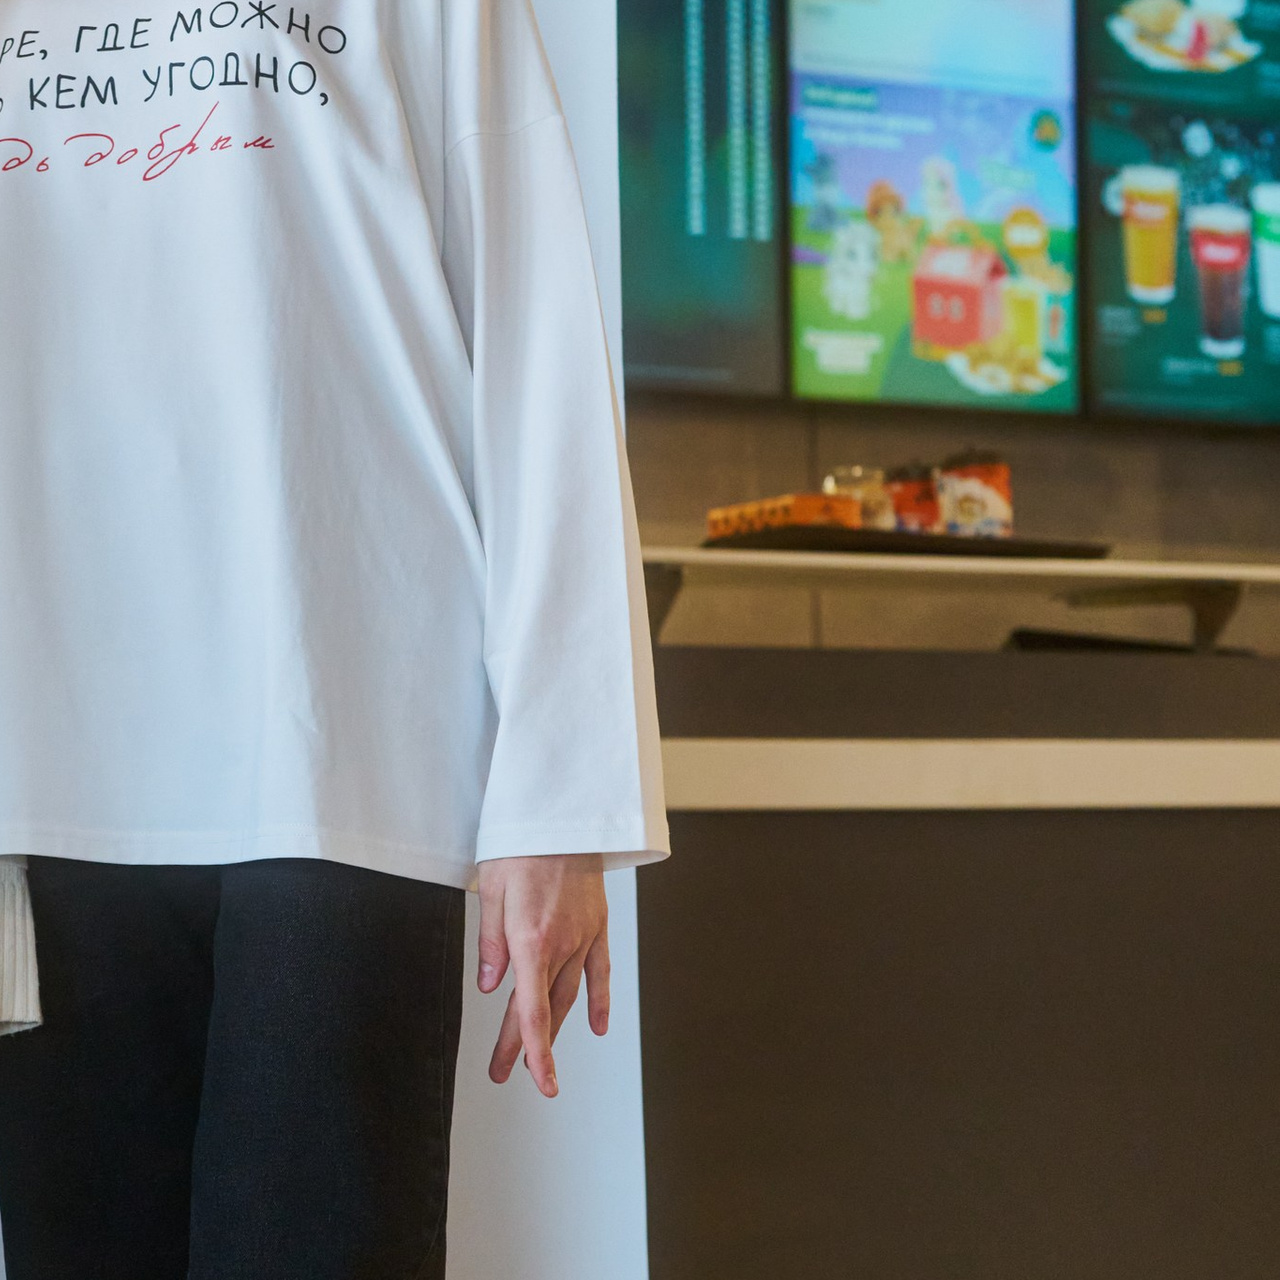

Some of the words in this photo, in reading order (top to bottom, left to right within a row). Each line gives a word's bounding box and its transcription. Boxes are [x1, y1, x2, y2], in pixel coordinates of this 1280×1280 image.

[75, 18, 152, 53] ГДЕ
[170, 0, 347, 54] МОЖНО
[28, 74, 118, 110] КЕМ
[142, 51, 329, 106] УГОДНО,
[63, 100, 275, 182] добрым
